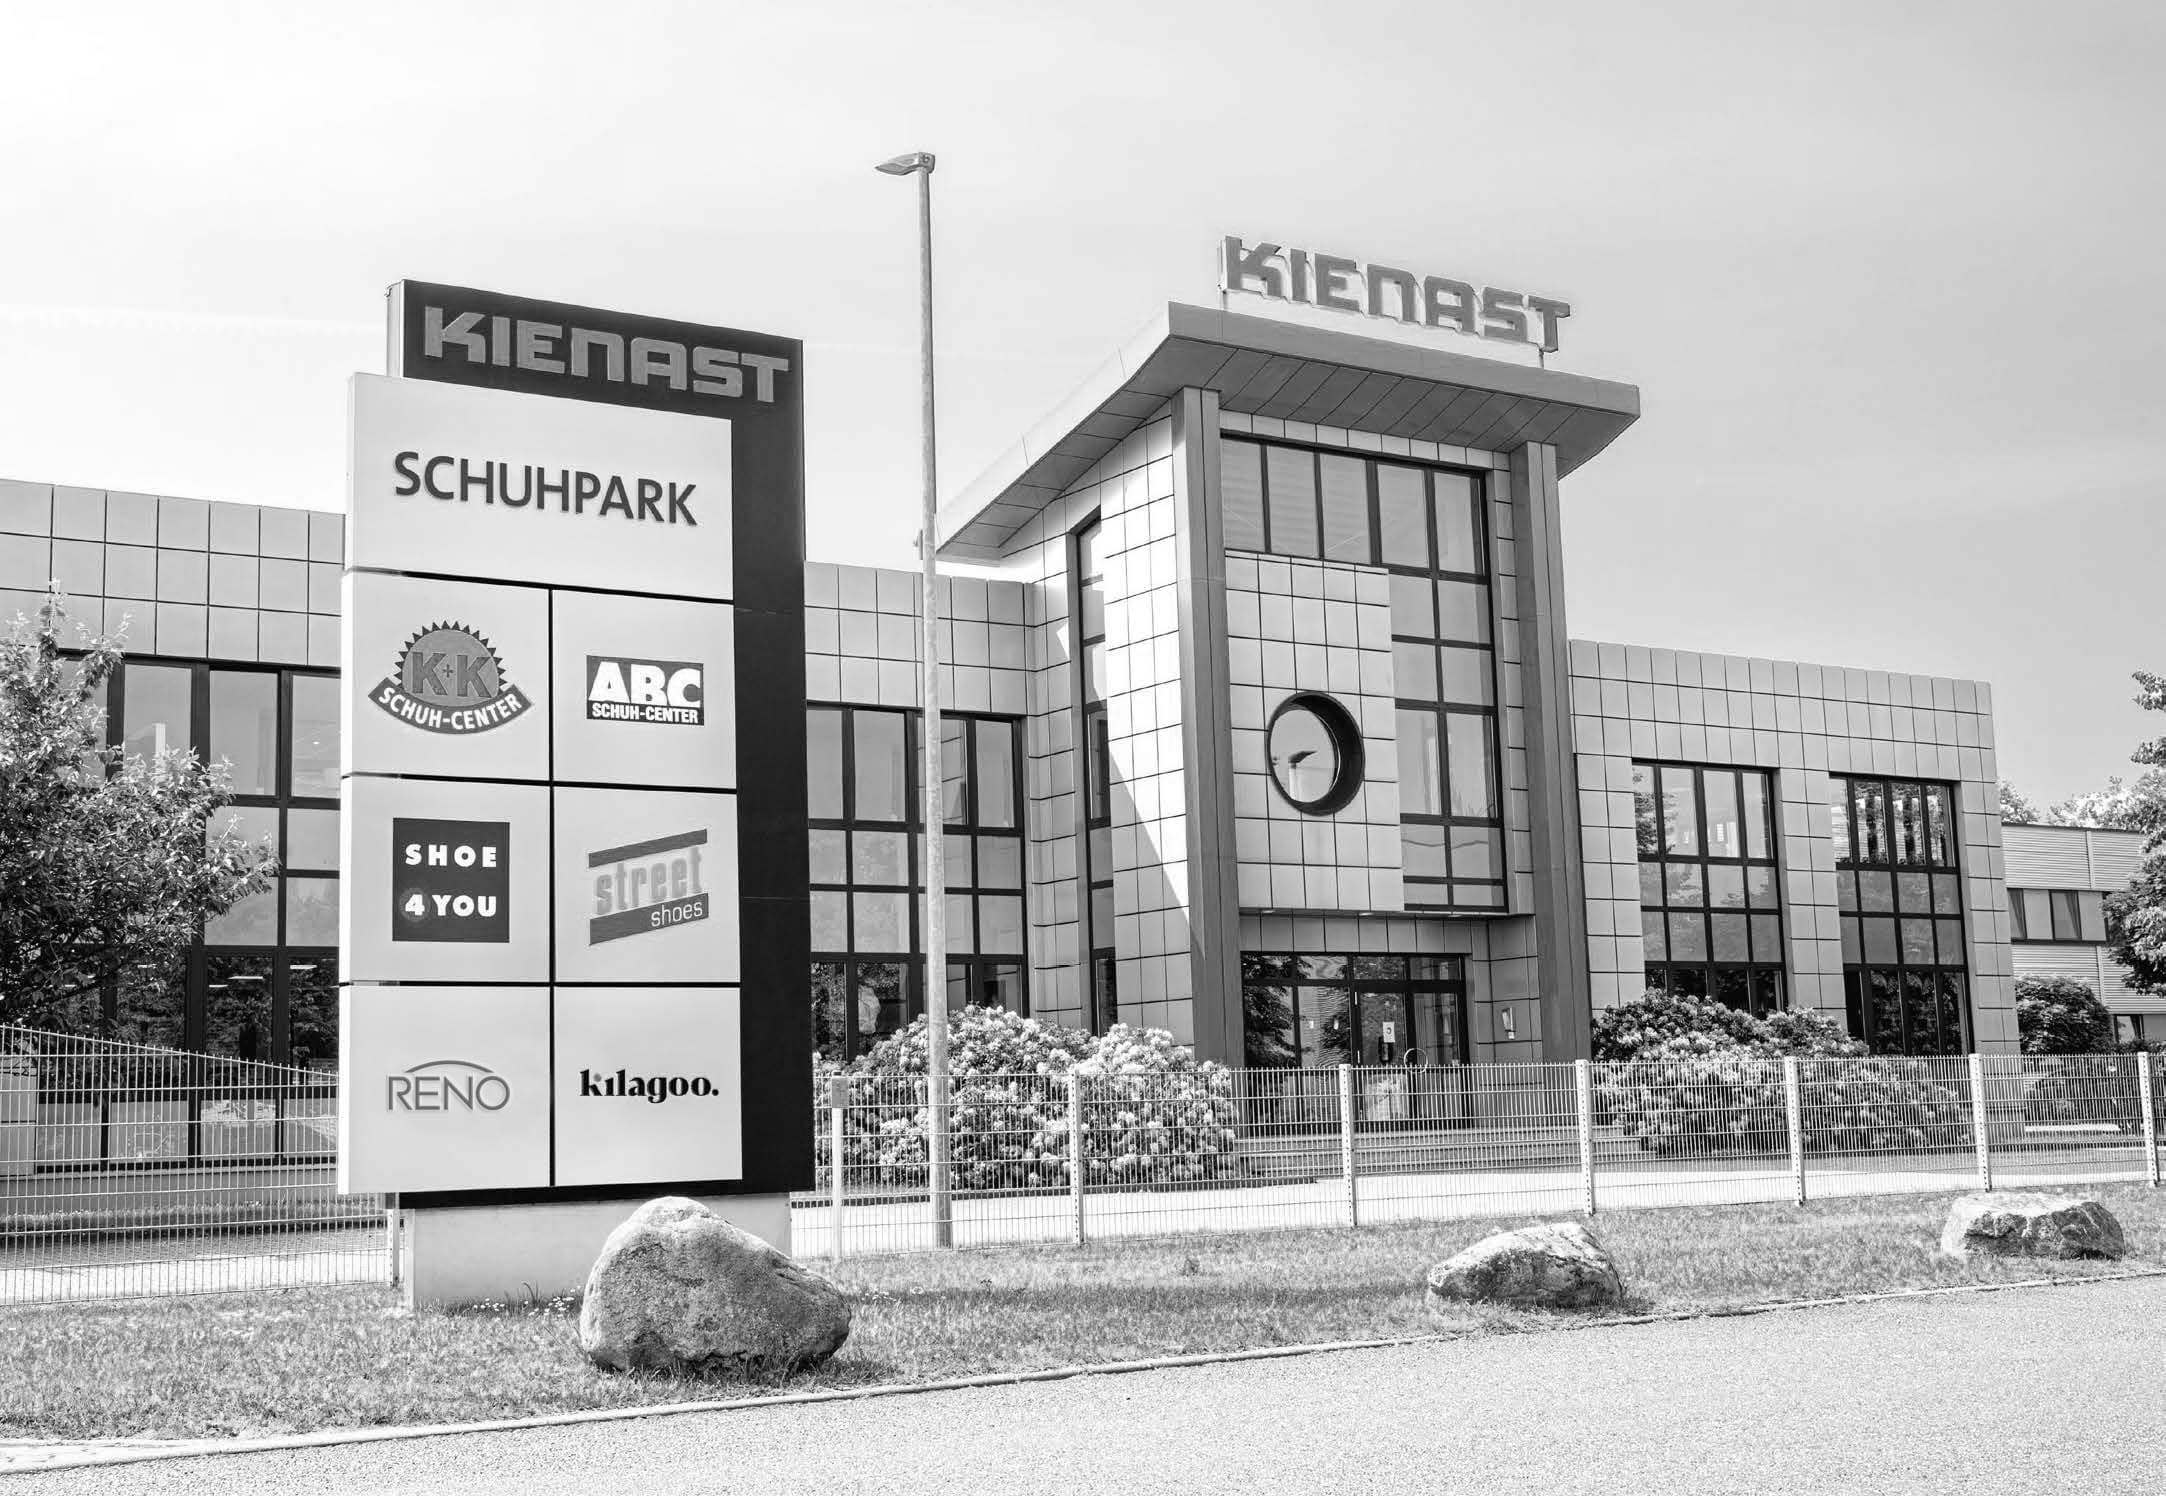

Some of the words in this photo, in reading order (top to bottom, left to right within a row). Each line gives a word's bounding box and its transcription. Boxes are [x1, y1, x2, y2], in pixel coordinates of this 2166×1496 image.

[1223, 235, 1571, 353] KIENAST
[424, 306, 789, 402] KIENAST
[394, 451, 698, 527] SCHUHPARK
[412, 651, 493, 698] K+K
[588, 660, 702, 708] ABC
[379, 687, 522, 730] SCHUH-CENTER
[592, 703, 699, 724] SCHUH-CENTER
[404, 843, 497, 868] SHOE
[593, 845, 703, 916] street
[404, 895, 426, 917] 4
[431, 895, 497, 918] YOU
[650, 900, 703, 928] shoes
[387, 1075, 511, 1111] RENO
[579, 1068, 720, 1104] kilagoo.
